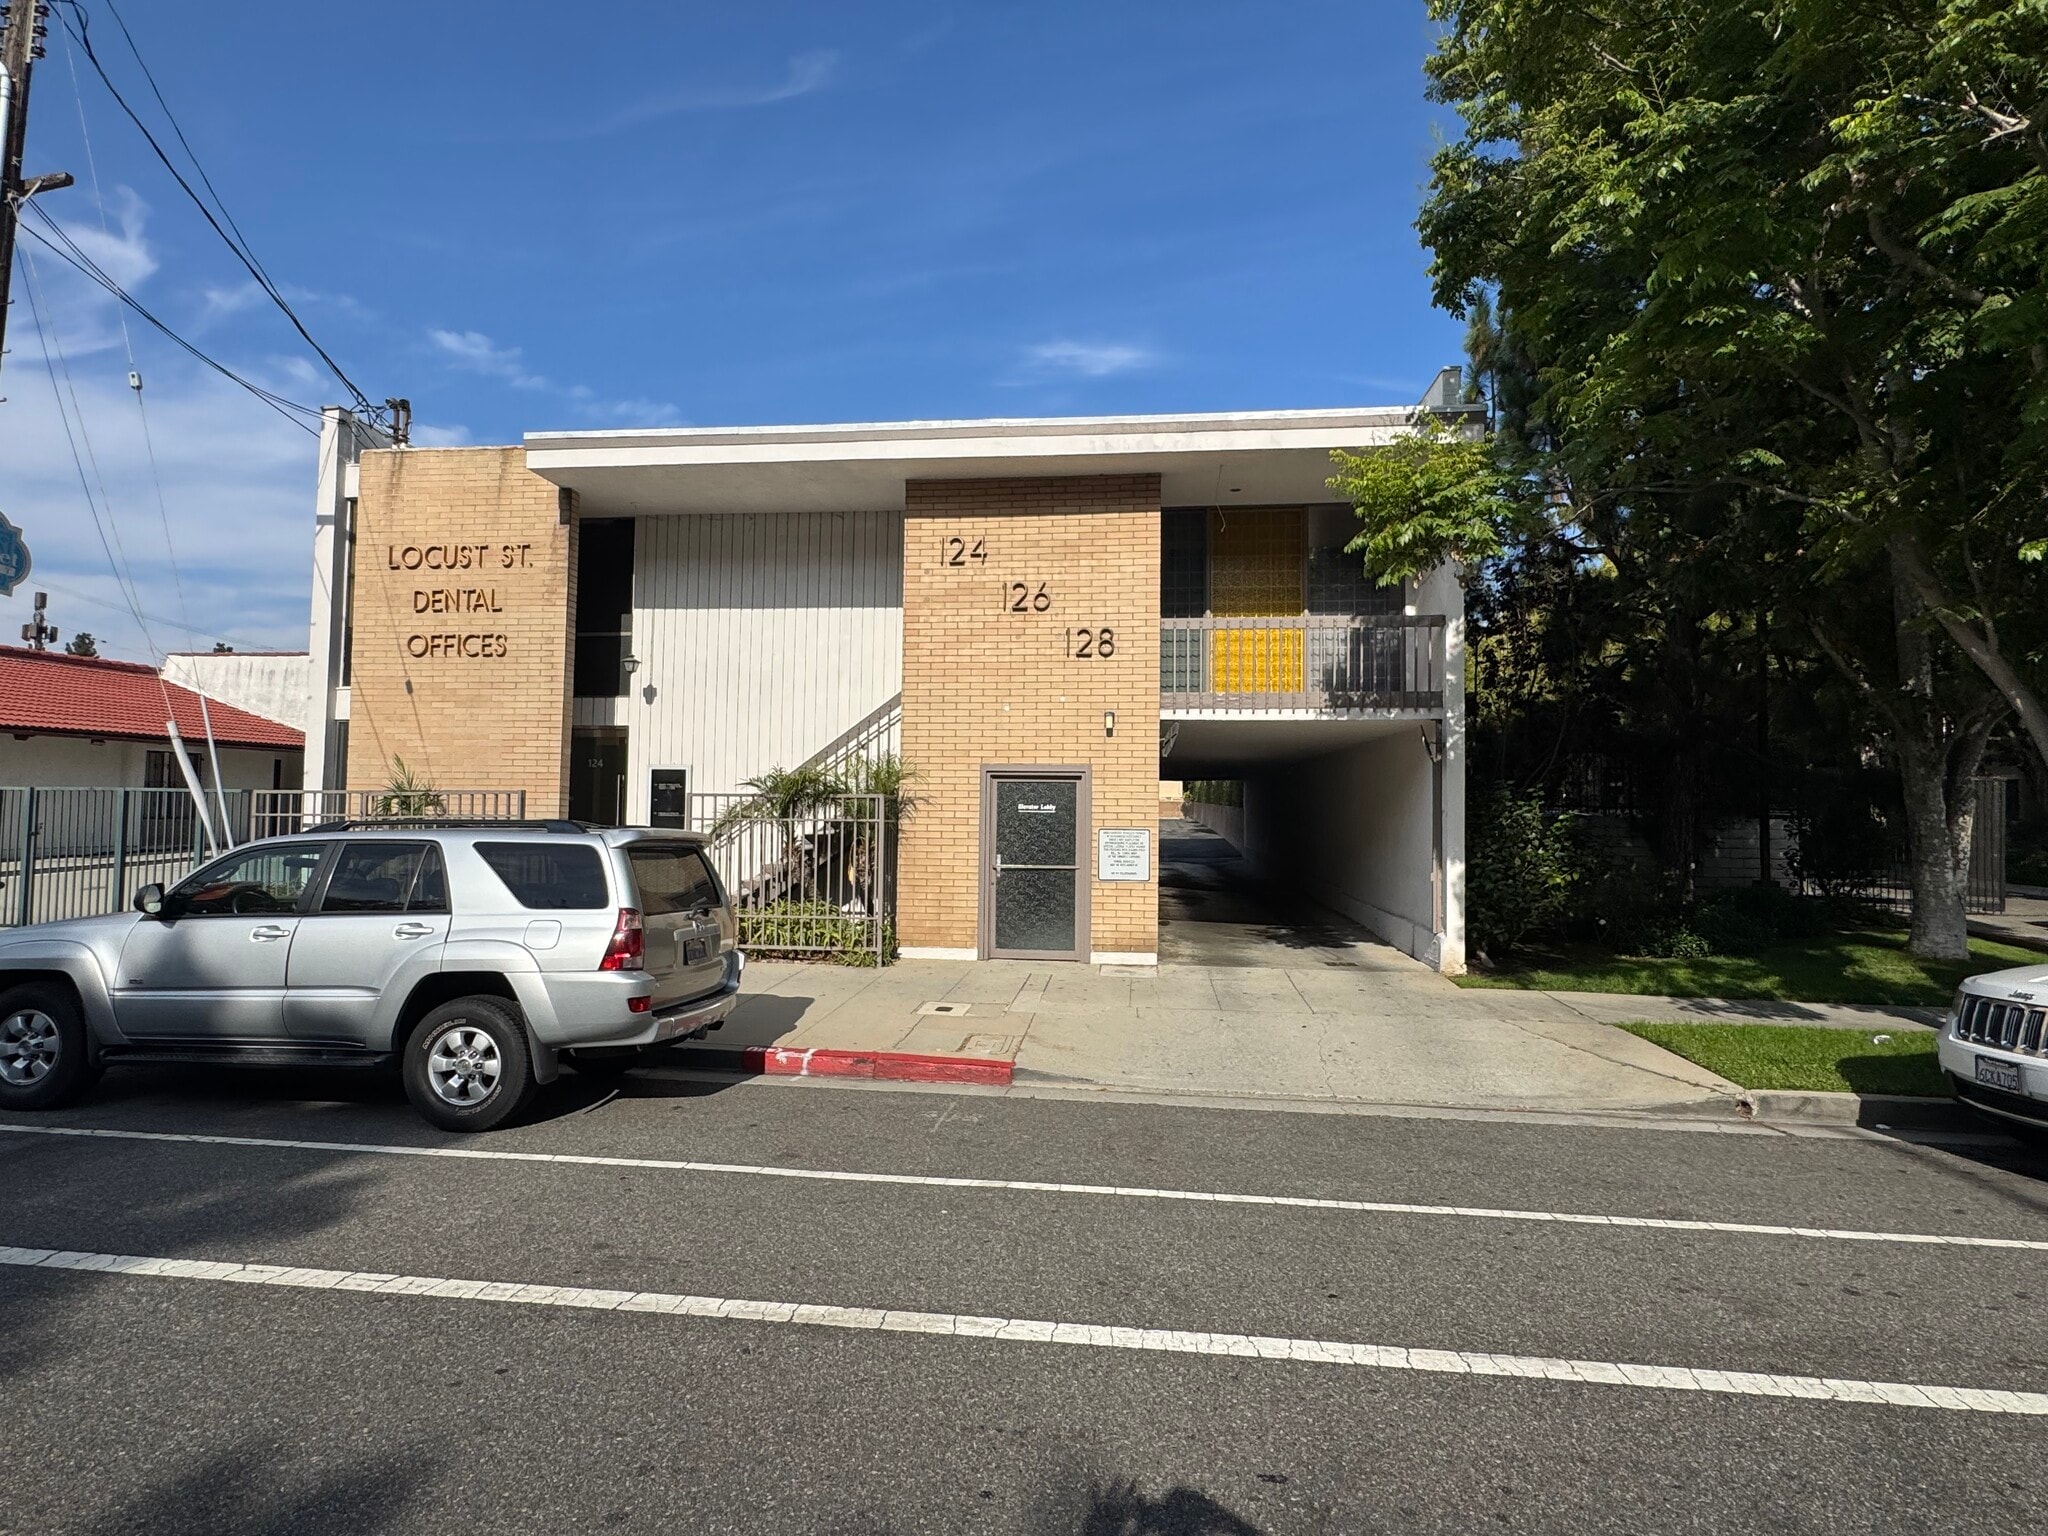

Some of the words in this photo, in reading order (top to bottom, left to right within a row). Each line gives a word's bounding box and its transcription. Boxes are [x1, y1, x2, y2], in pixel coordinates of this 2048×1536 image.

[388, 544, 489, 570] LOCUST
[501, 543, 533, 569] ST.
[940, 535, 988, 567] 124
[413, 588, 503, 614] DENTAL
[1002, 581, 1051, 613] 126
[407, 633, 508, 658] OFFICES
[1065, 627, 1115, 658] 128
[587, 758, 604, 768] 124
